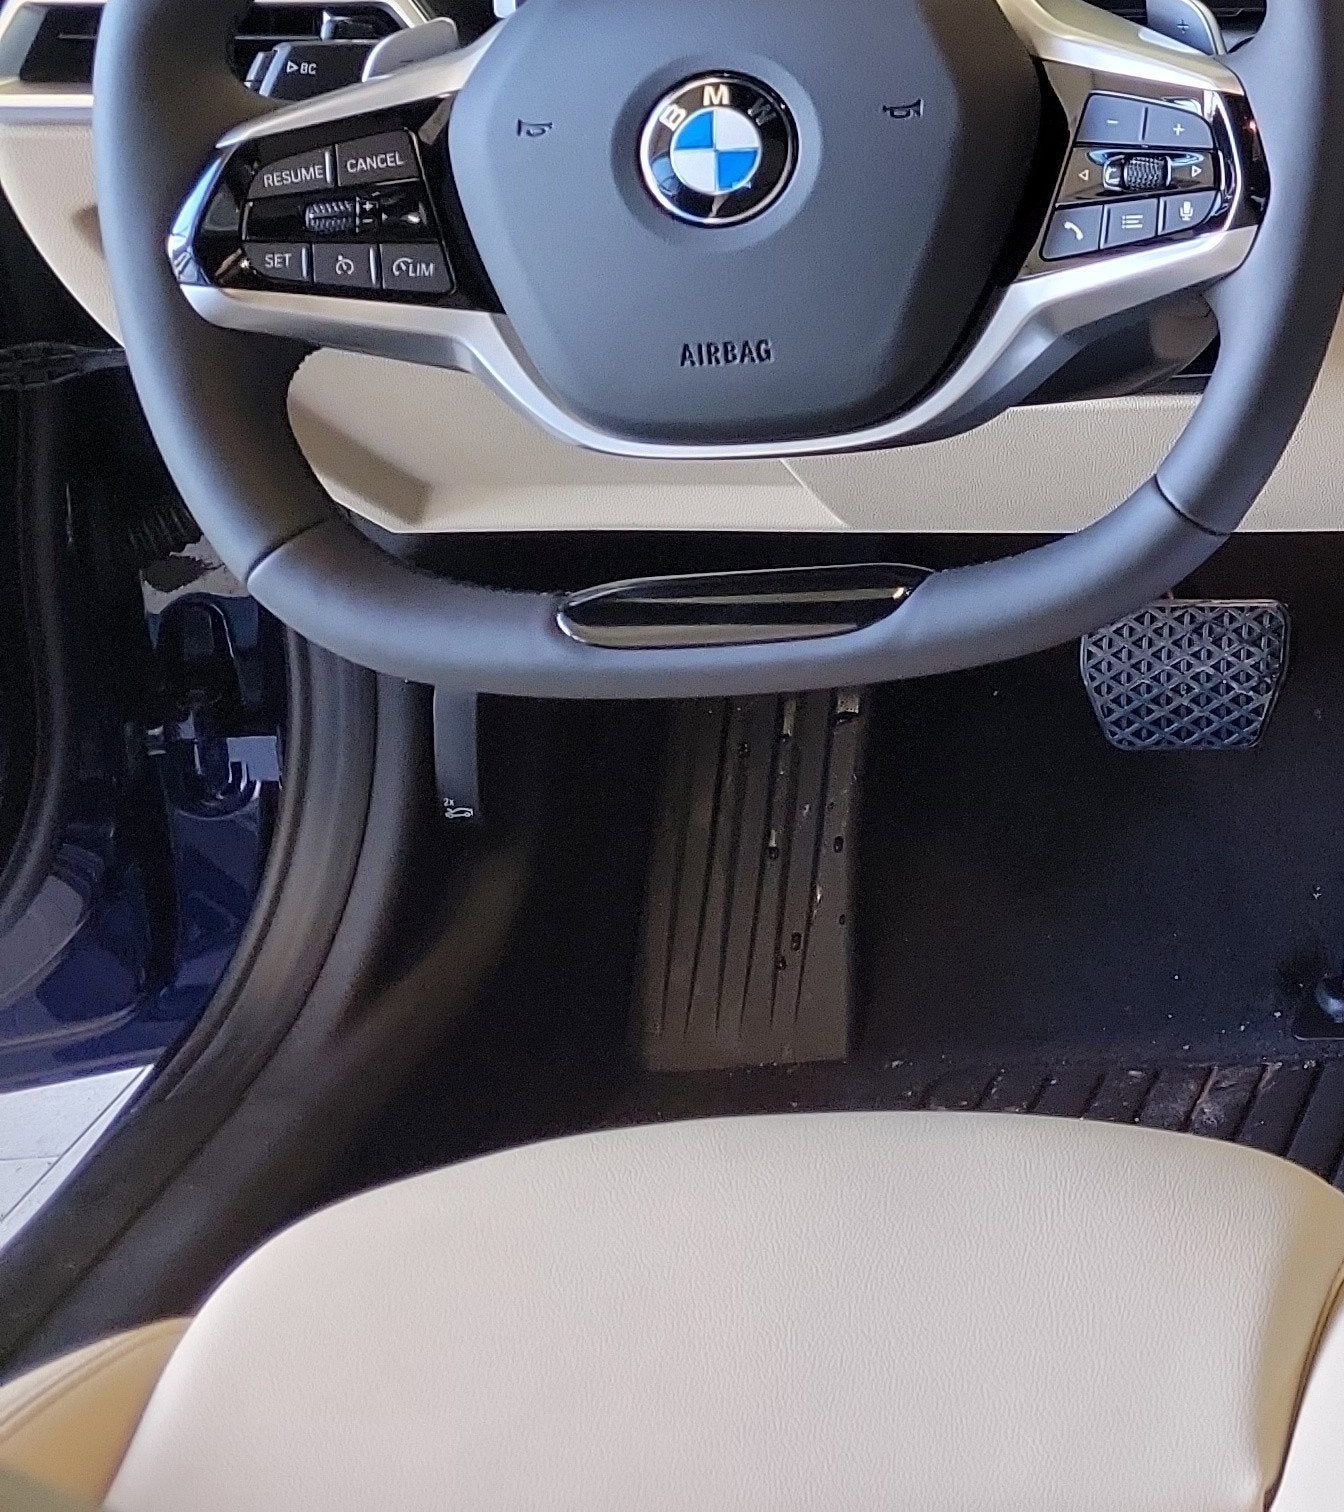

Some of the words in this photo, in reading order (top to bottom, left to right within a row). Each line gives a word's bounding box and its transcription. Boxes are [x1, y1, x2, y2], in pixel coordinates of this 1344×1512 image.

[346, 151, 405, 173] CANCEL
[263, 164, 325, 188] RESUME
[264, 253, 292, 269] SET
[408, 262, 435, 277] LIM
[680, 338, 772, 367] AIRBAG
